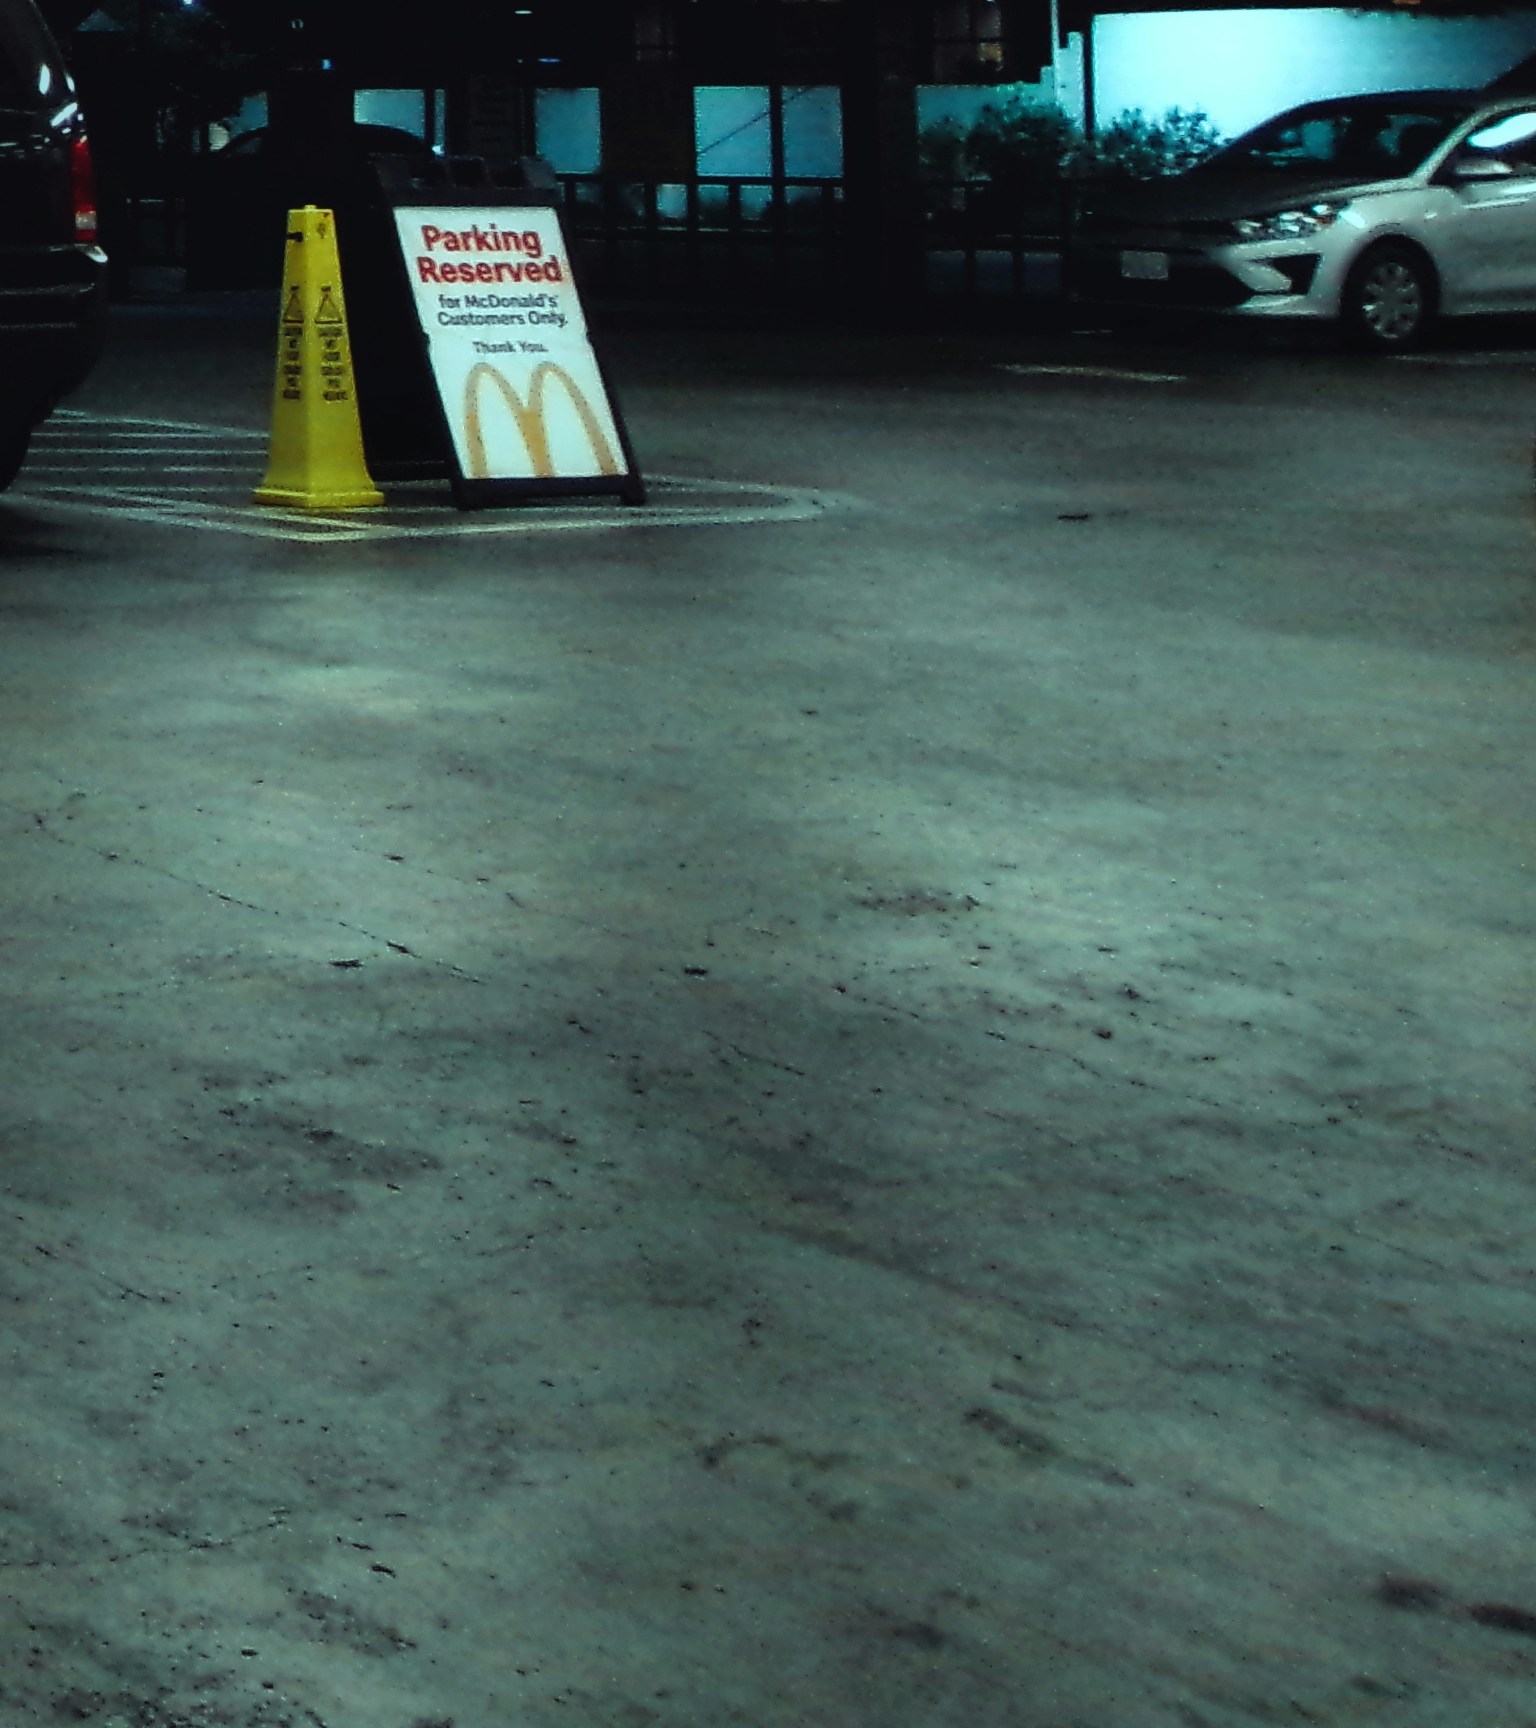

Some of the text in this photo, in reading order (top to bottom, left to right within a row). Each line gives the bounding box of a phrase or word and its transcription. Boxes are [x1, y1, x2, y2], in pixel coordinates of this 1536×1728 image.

[421, 223, 542, 258] Parking
[417, 254, 563, 283] Reserved
[438, 293, 557, 308] for McDonald's
[437, 312, 525, 326] Customers
[472, 341, 516, 353] Thank
